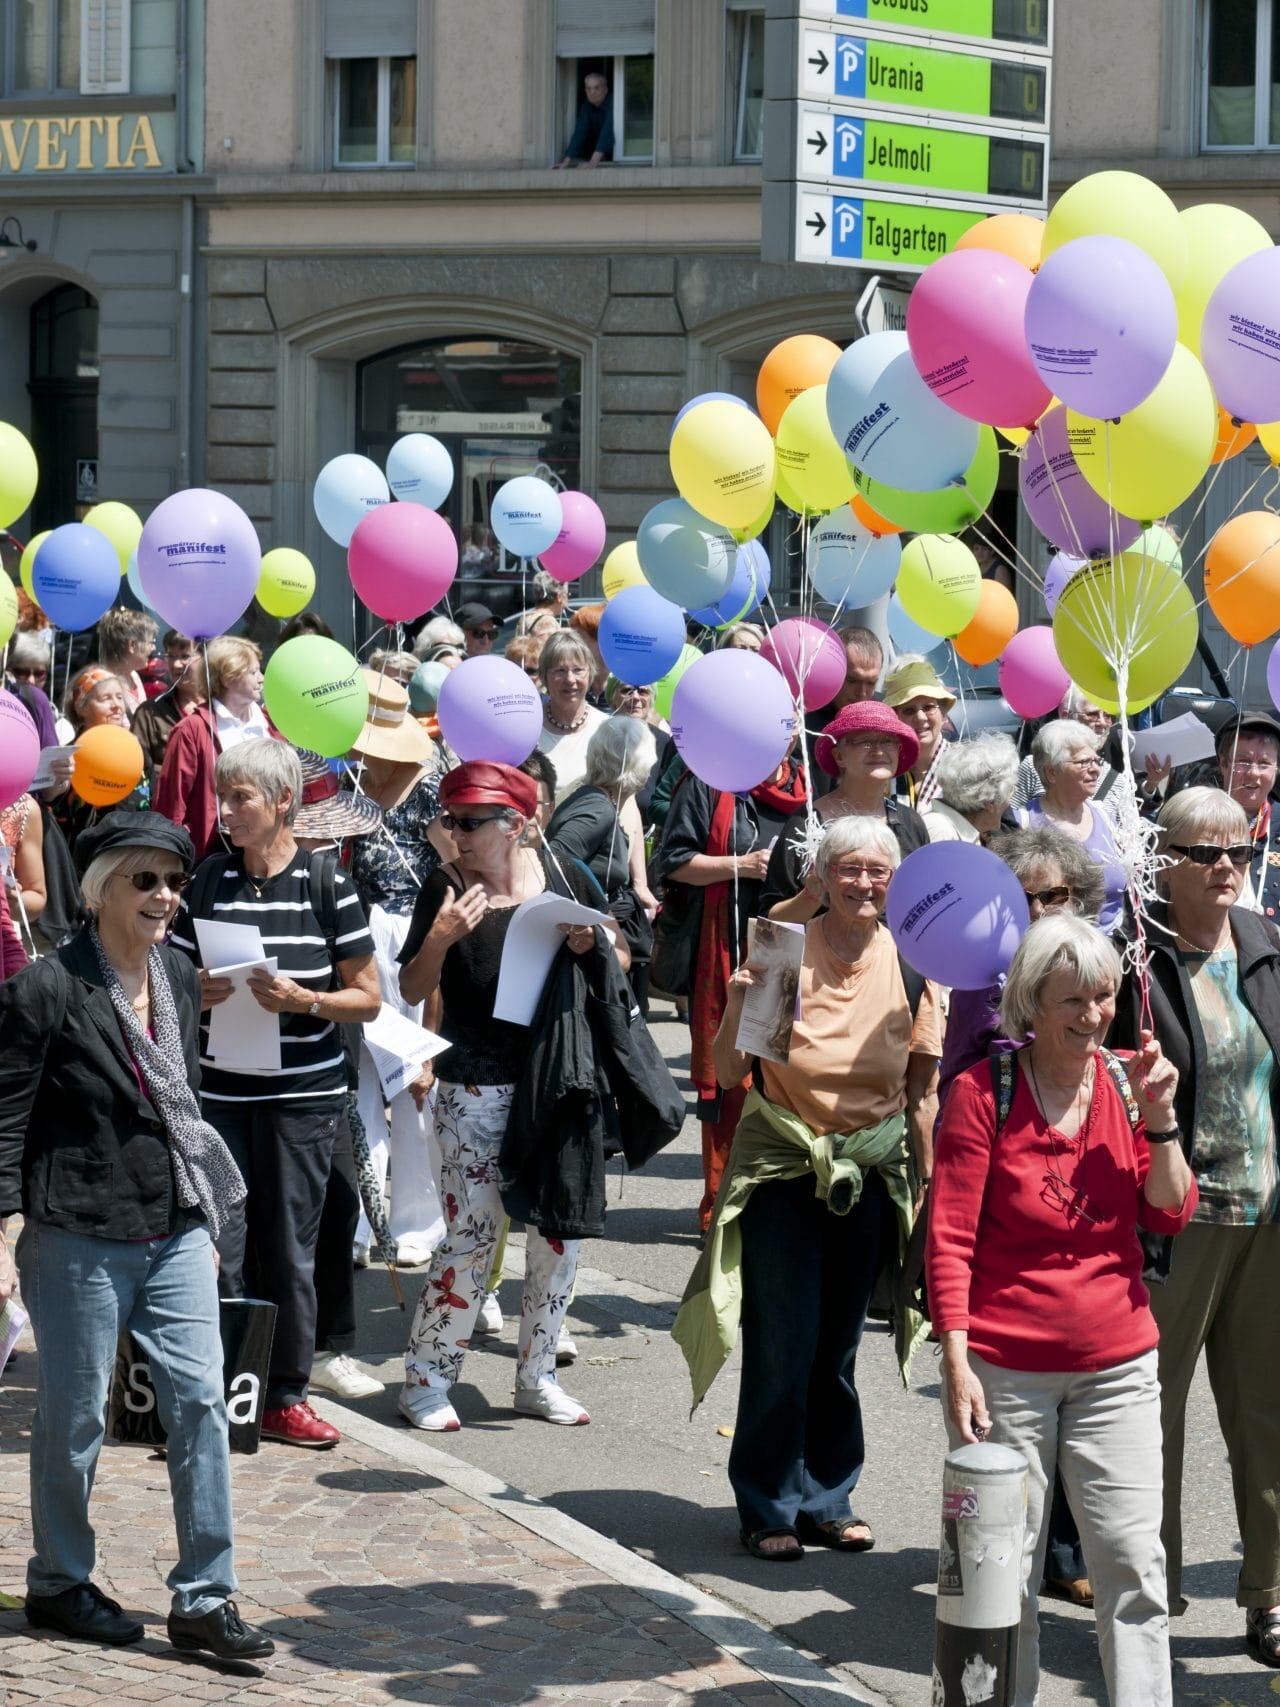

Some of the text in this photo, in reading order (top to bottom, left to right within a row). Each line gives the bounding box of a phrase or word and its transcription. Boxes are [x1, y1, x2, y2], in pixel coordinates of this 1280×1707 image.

[870, 56, 923, 92] Urania
[868, 137, 931, 173] Jelmoli
[867, 216, 947, 256] Talgarten
[1241, 317, 1265, 330] bieten!
[1244, 328, 1264, 341] haben
[167, 542, 226, 556] manifest
[311, 678, 356, 698] manifest
[904, 882, 954, 932] manifest
